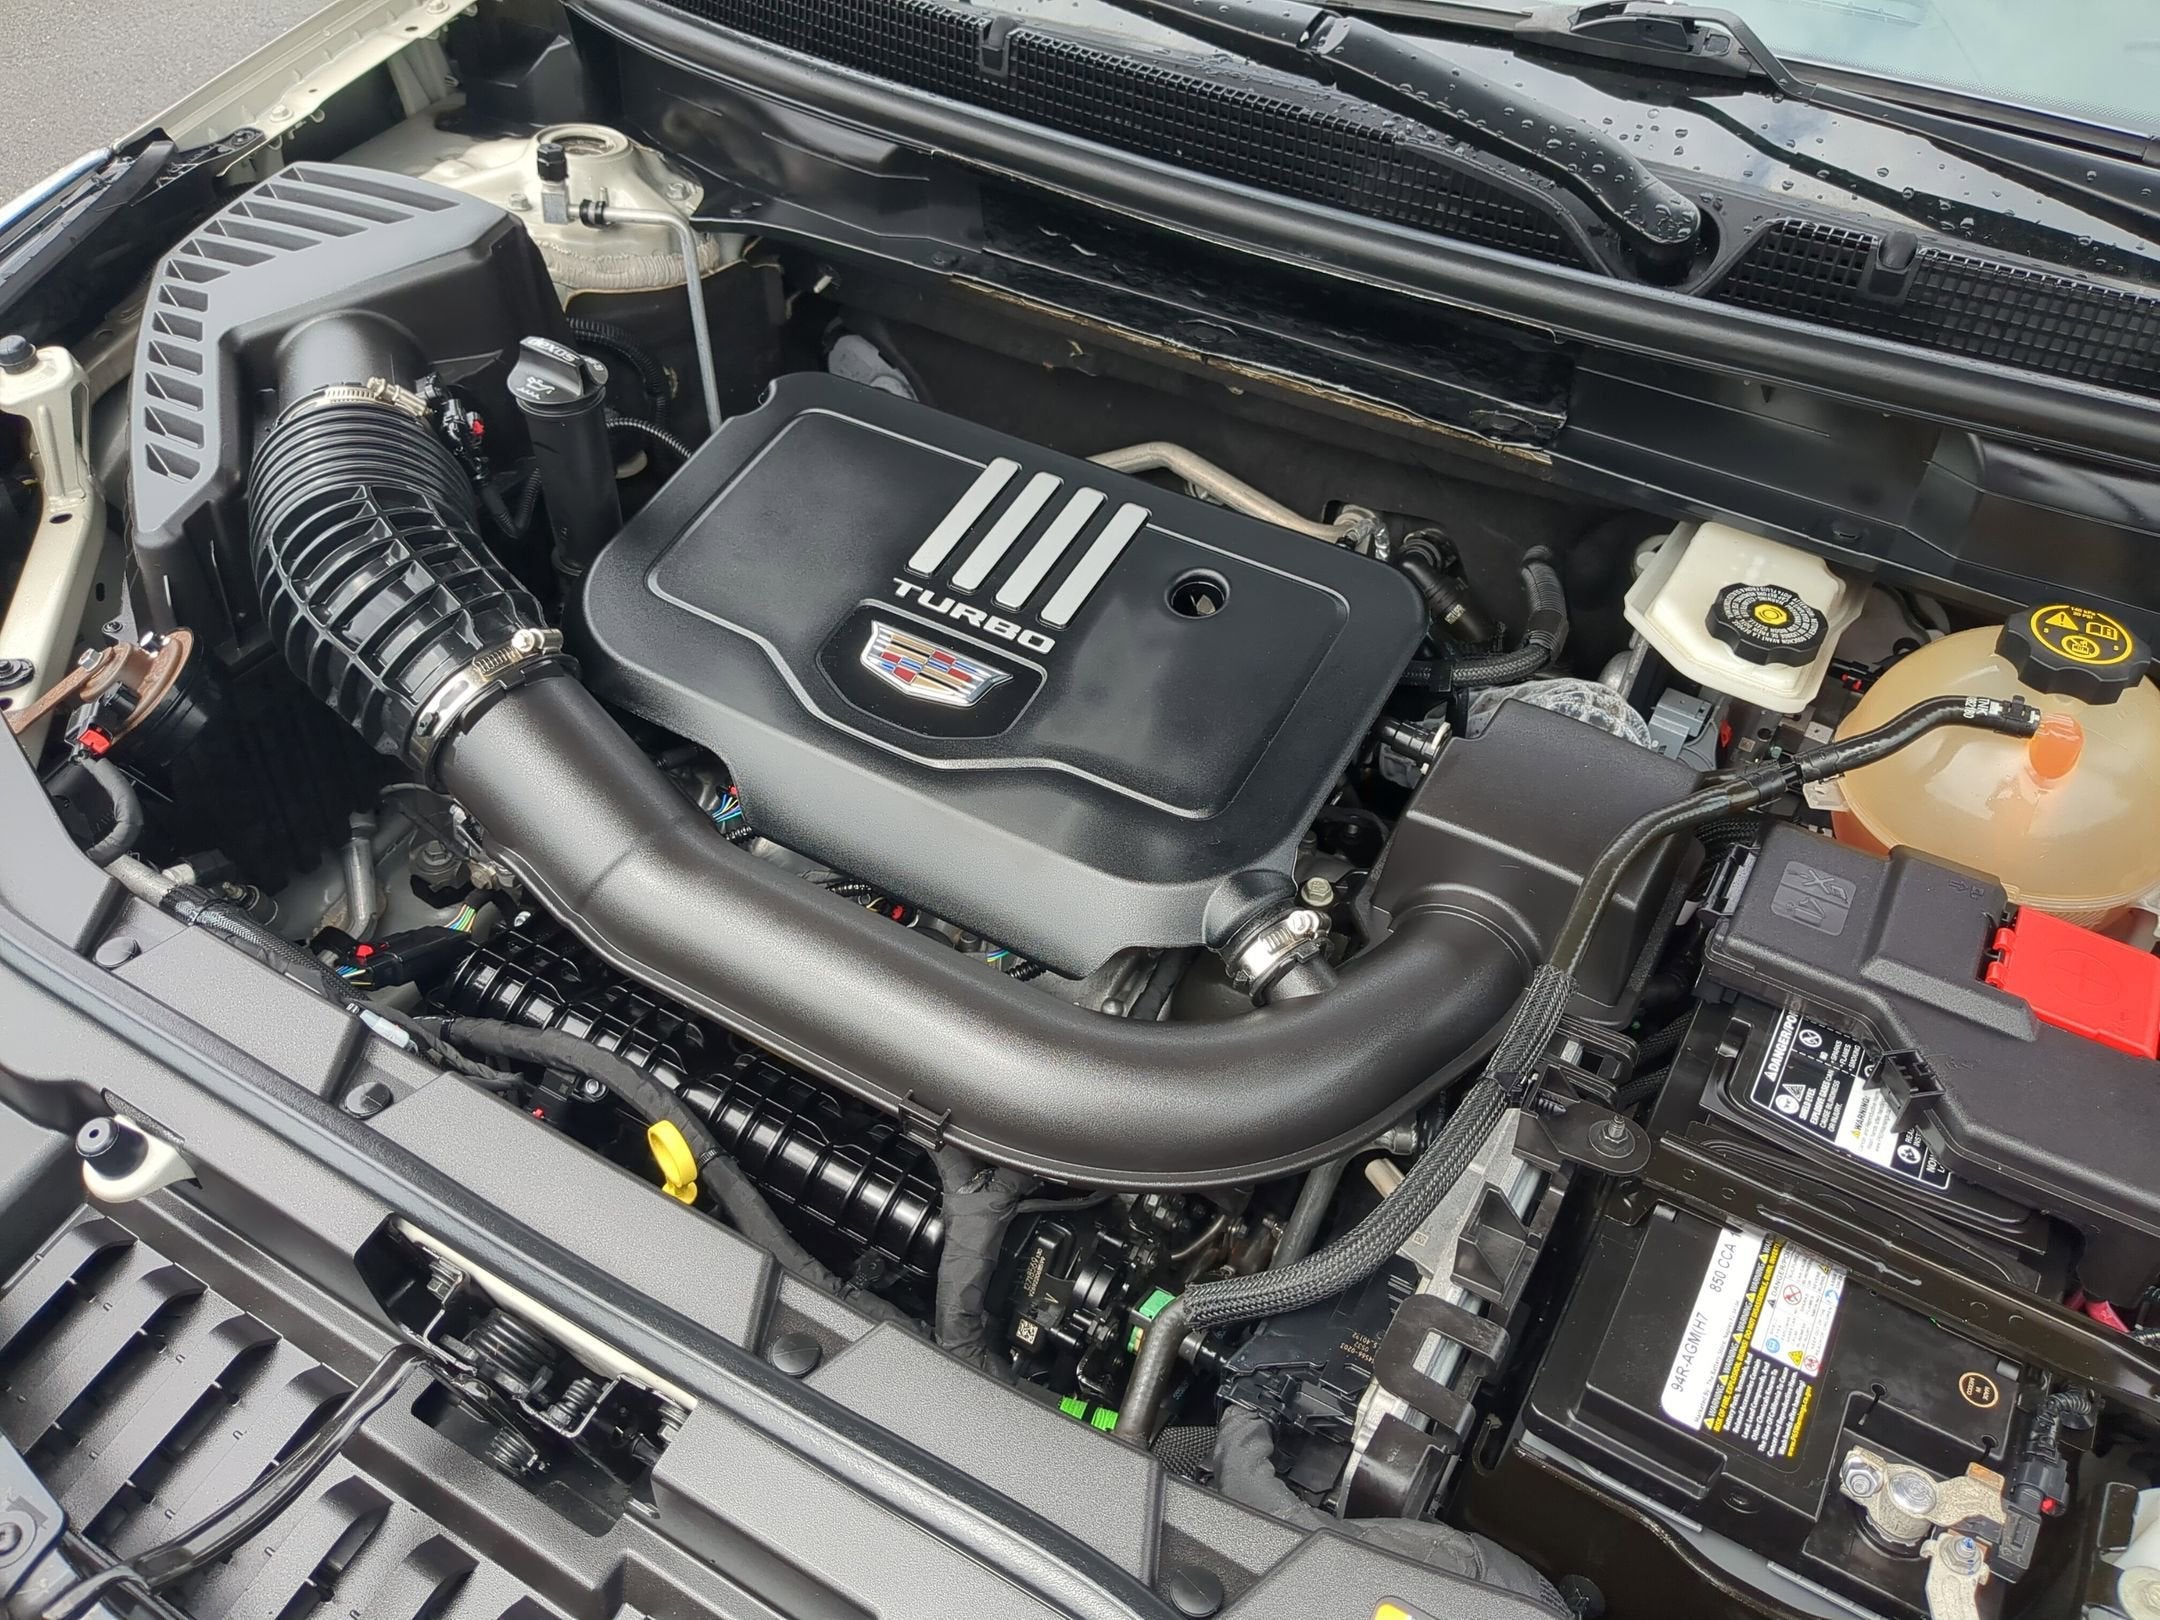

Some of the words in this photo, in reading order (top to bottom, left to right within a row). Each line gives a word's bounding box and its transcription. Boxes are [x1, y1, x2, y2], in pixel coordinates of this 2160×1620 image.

[527, 337, 580, 362] dexos
[892, 576, 1056, 655] TURBO
[1809, 1096, 1825, 1124] EXPLOSIVE
[1818, 1080, 1831, 1097] GASES
[1825, 1069, 1834, 1081] CAN
[1819, 1109, 1831, 1128] CAUSE
[1825, 1079, 1840, 1109] BLINDNESS
[1854, 1095, 1870, 1130] WARNING:
[1828, 1122, 1836, 1132] OR
[1716, 1241, 1736, 1269] CCA
[1708, 1269, 1727, 1293] 850
[1744, 1328, 1752, 1339] DO
[1747, 1317, 1756, 1330] NOT
[1708, 1383, 1724, 1417] WARNING
[1723, 1341, 1738, 1374] WARNING
[1736, 1300, 1753, 1332] WARNING
[1748, 1262, 1765, 1292] WARNING
[1779, 1366, 1788, 1383] Cause
[1723, 1408, 1735, 1430] Battery
[1744, 1352, 1753, 1364] And
[1732, 1410, 1744, 1433] Related
[1739, 1379, 1754, 1411] Accessories
[1749, 1357, 1761, 1380] Contain
[1746, 1407, 1756, 1422] Lead
[1761, 1361, 1770, 1374] And
[1718, 1407, 1726, 1417] OF
[1751, 1423, 1761, 1441] Other
[1756, 1395, 1770, 1423] Chemicals
[1765, 1375, 1776, 1395] Known
[1771, 1368, 1778, 1376] To
[1768, 1389, 1782, 1417] California
[1776, 1387, 1793, 1425] Reproductive
[1787, 1405, 1798, 1421] after
[1713, 1416, 1723, 1431] RISK
[1766, 1416, 1773, 1425] Of
[1773, 1424, 1781, 1436] And
[1782, 1420, 1793, 1439] hands
[1761, 1424, 1771, 1440] State
[1758, 1439, 1767, 1451] The
[1767, 1436, 1778, 1457] Cancer
[1777, 1438, 1788, 1455] Wash
